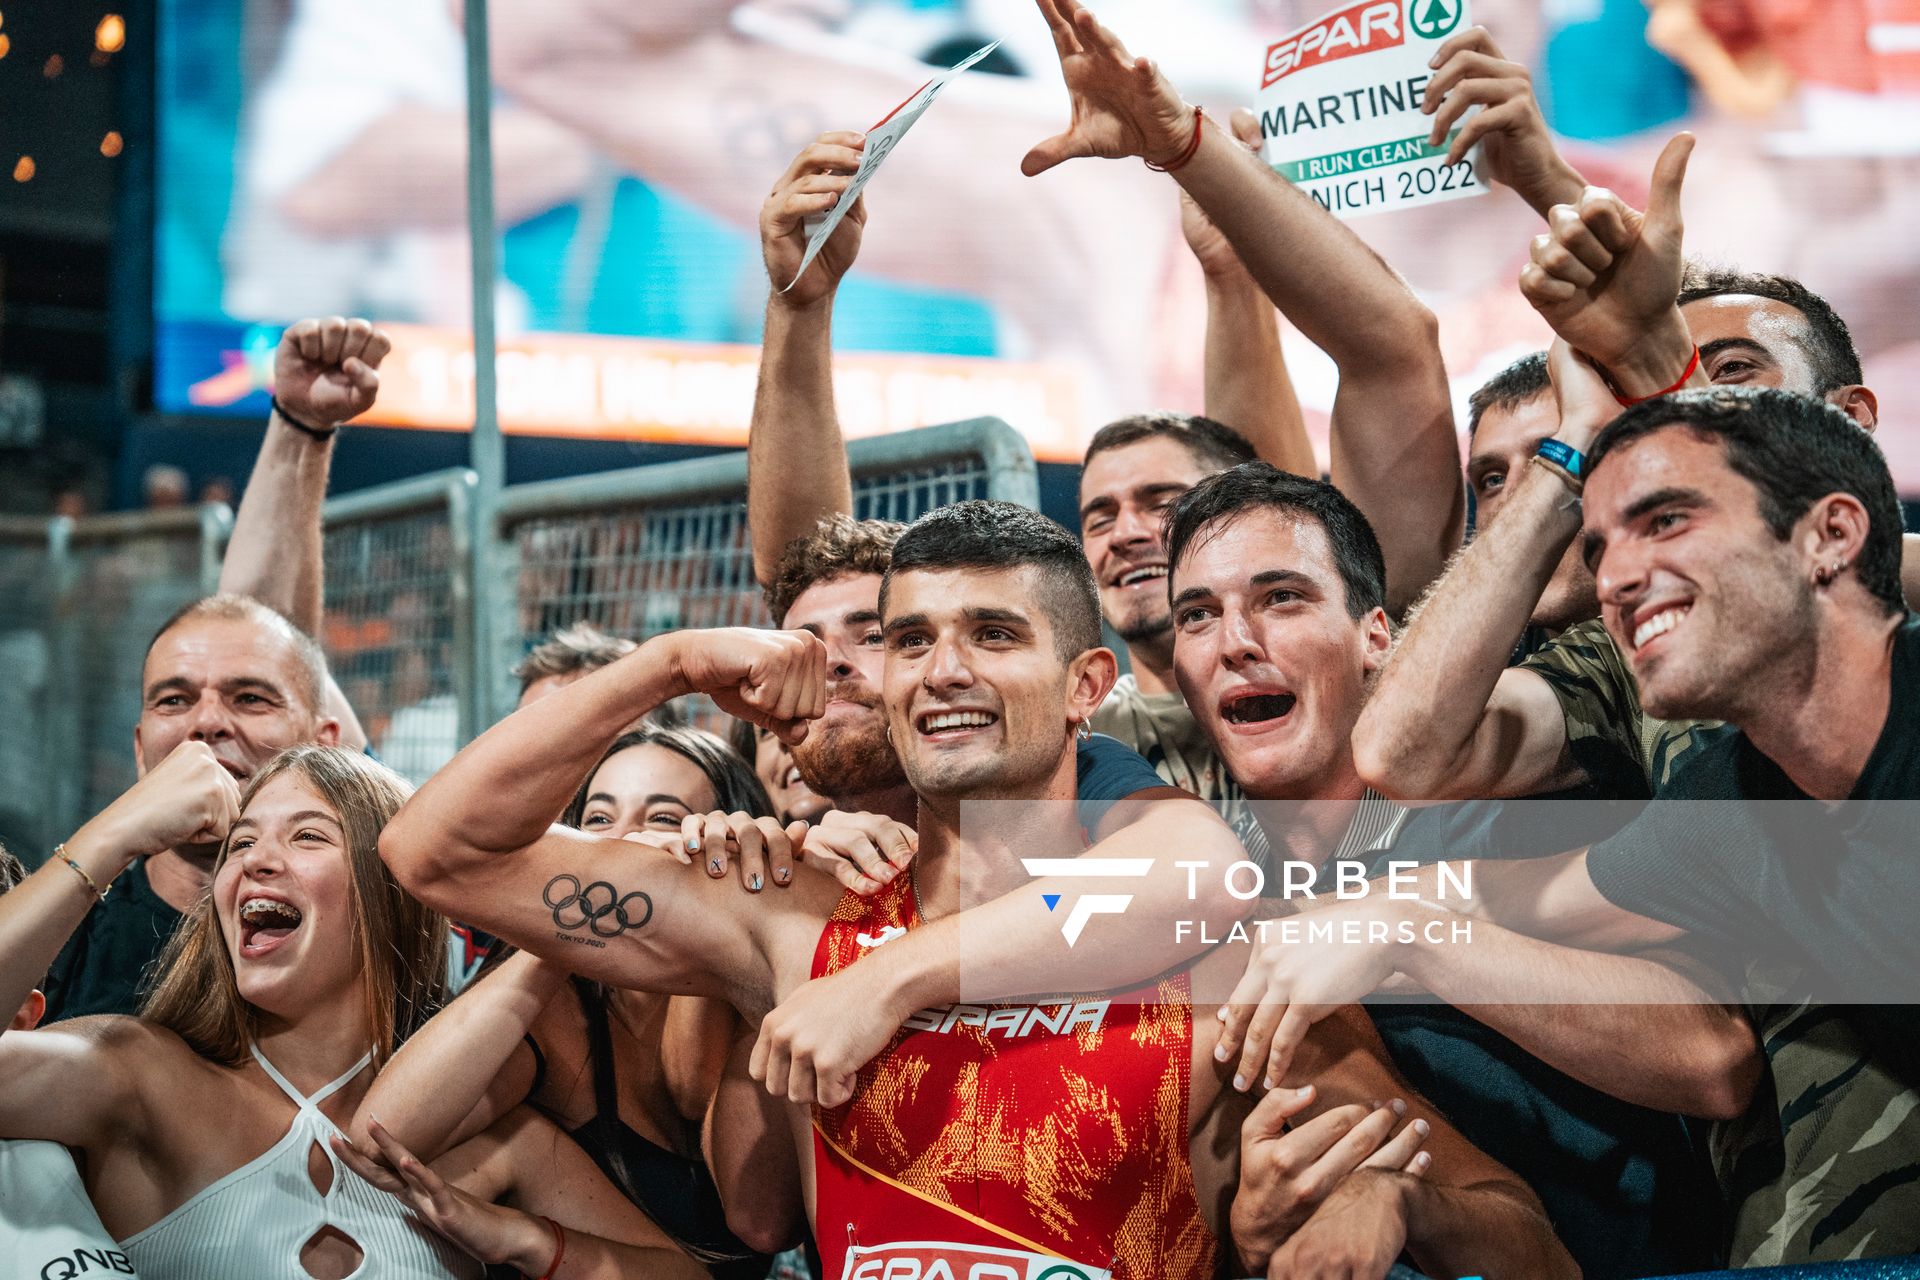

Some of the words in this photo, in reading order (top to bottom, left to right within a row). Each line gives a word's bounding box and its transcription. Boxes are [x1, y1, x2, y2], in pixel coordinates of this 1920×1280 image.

[1265, 2, 1399, 82] SPAR
[1261, 74, 1439, 139] MARTINE
[1298, 163, 1304, 180] I
[1309, 152, 1353, 178] RUN
[1312, 177, 1384, 211] NICH
[1398, 160, 1475, 199] 2022
[555, 932, 585, 944] TOKYO
[585, 938, 606, 949] 2020
[901, 1000, 1112, 1038] SPAÑA
[40, 1248, 135, 1280] QNB
